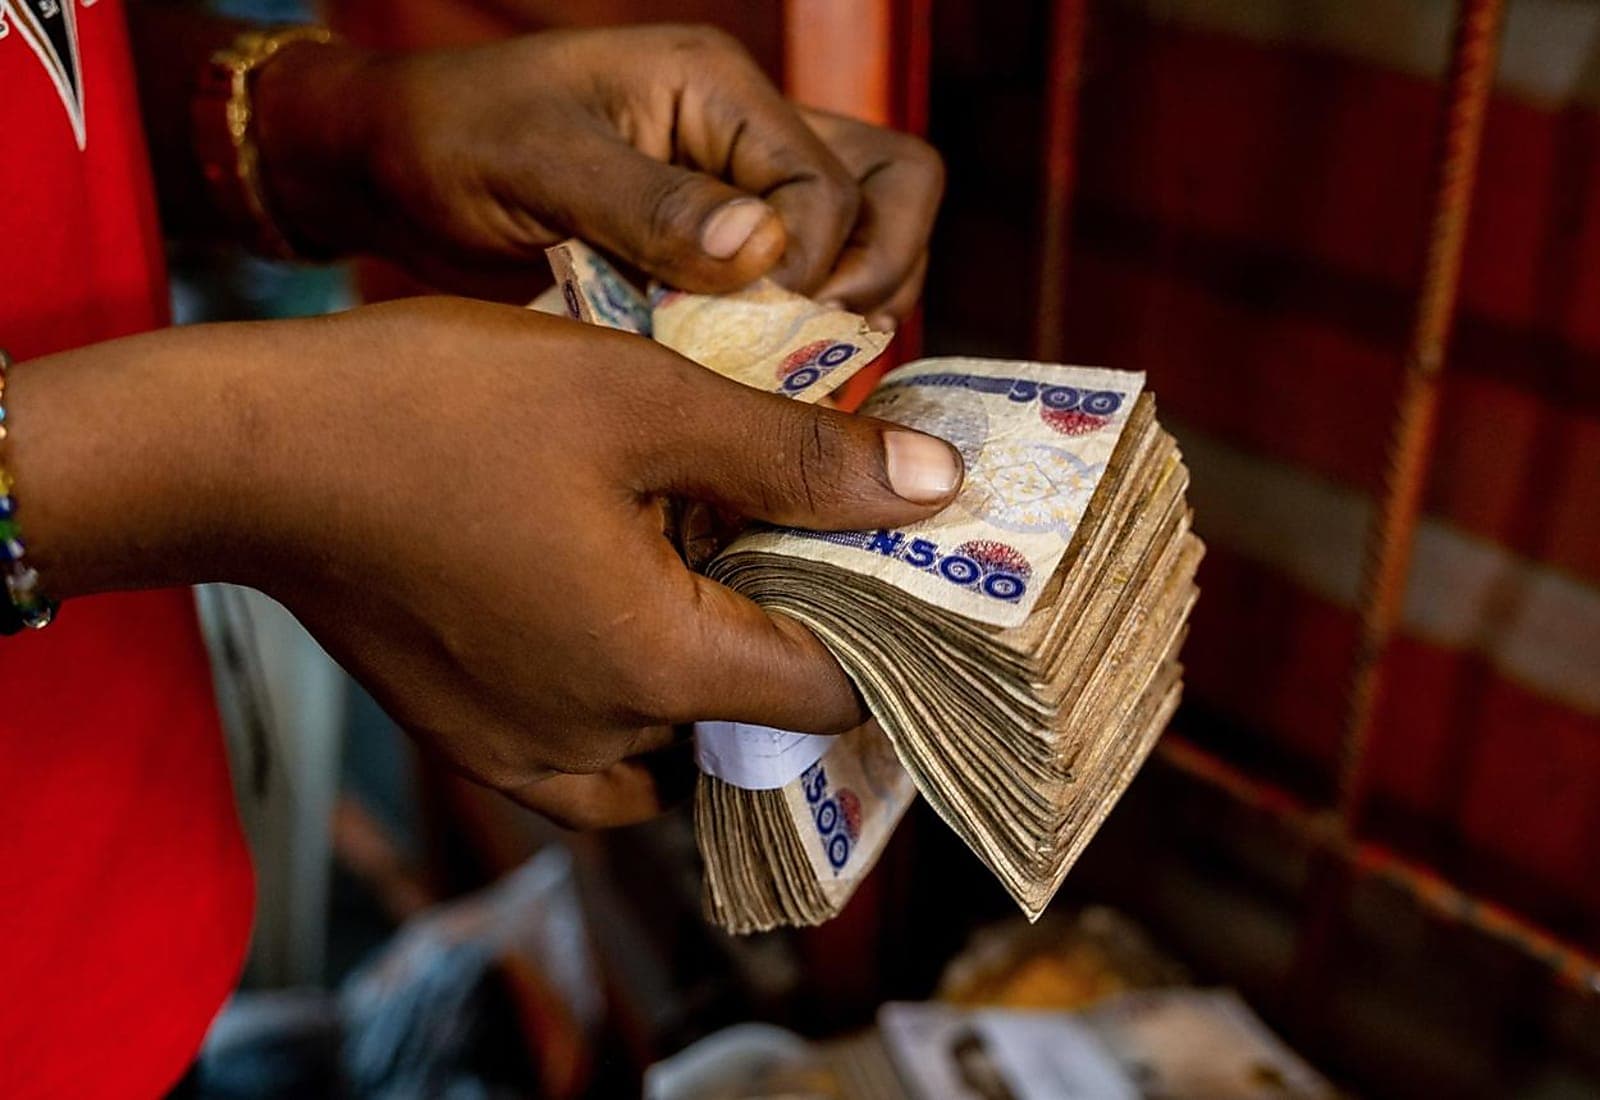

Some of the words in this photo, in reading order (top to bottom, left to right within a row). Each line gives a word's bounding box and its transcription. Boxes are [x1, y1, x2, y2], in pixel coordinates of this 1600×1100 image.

[781, 343, 858, 392] 00
[1008, 378, 1123, 415] 500
[801, 762, 849, 869] 500
